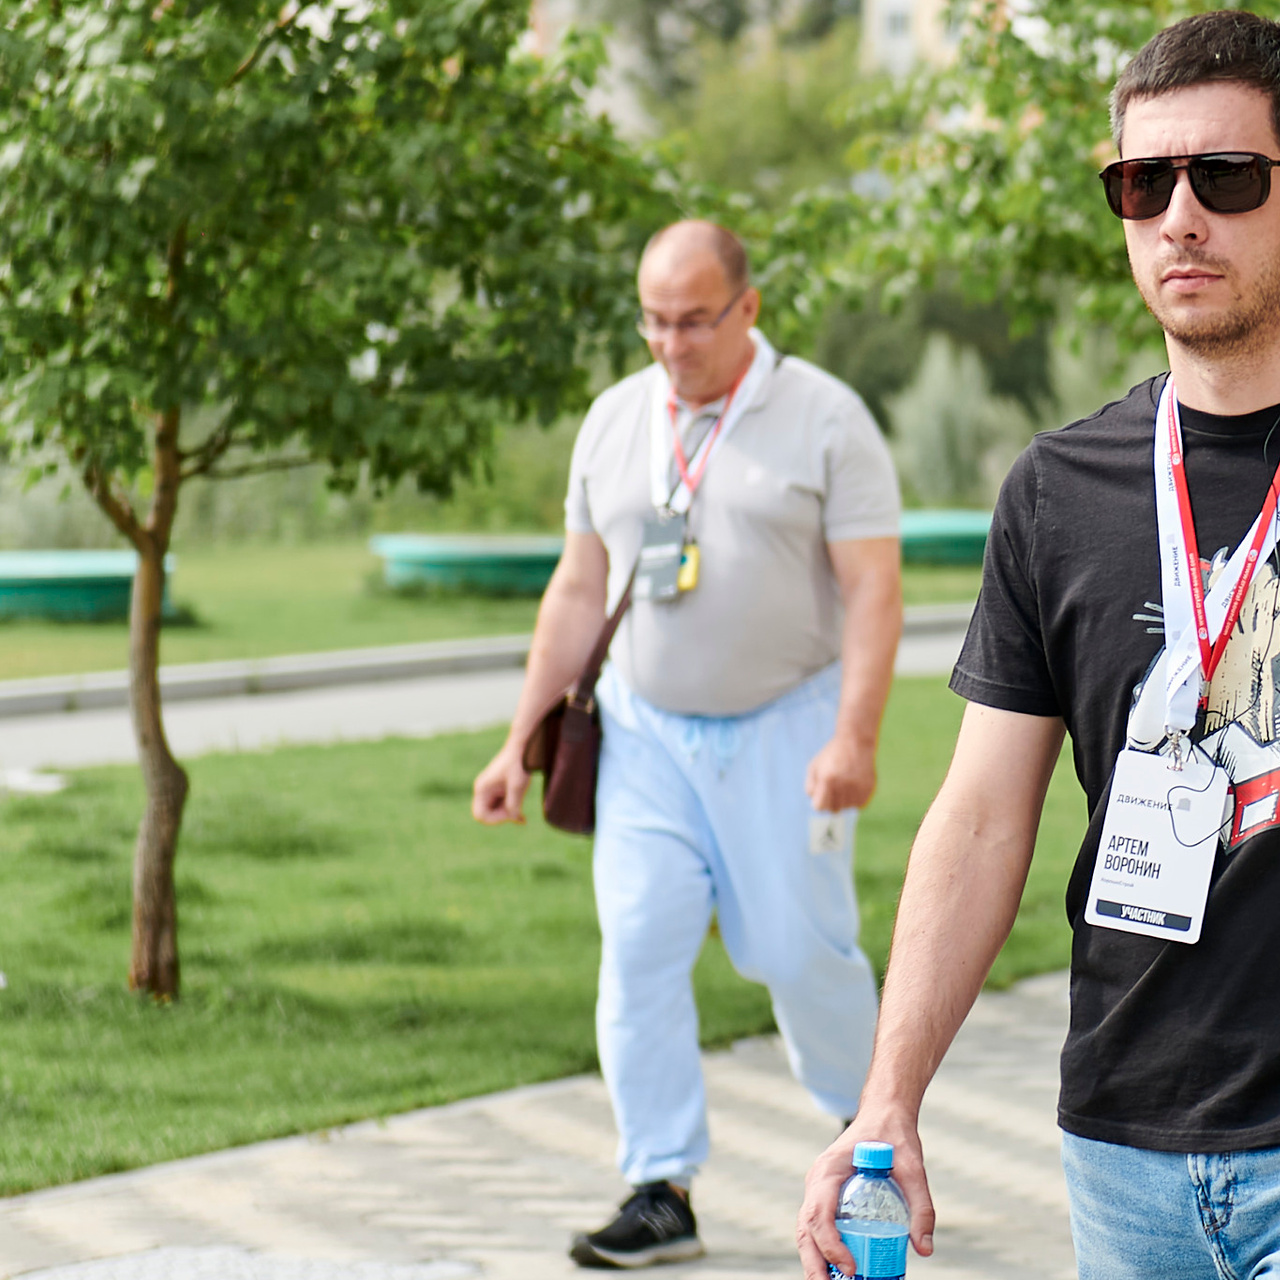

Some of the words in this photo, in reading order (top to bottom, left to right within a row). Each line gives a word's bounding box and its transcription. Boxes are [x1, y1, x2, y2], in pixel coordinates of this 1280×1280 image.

[1116, 794, 1173, 811] ДВИЖЕНИЕ
[1107, 834, 1149, 857] АРТЕМ
[1104, 854, 1161, 880] ВОРОНИН
[1120, 905, 1167, 926] УЧАСТНИК
